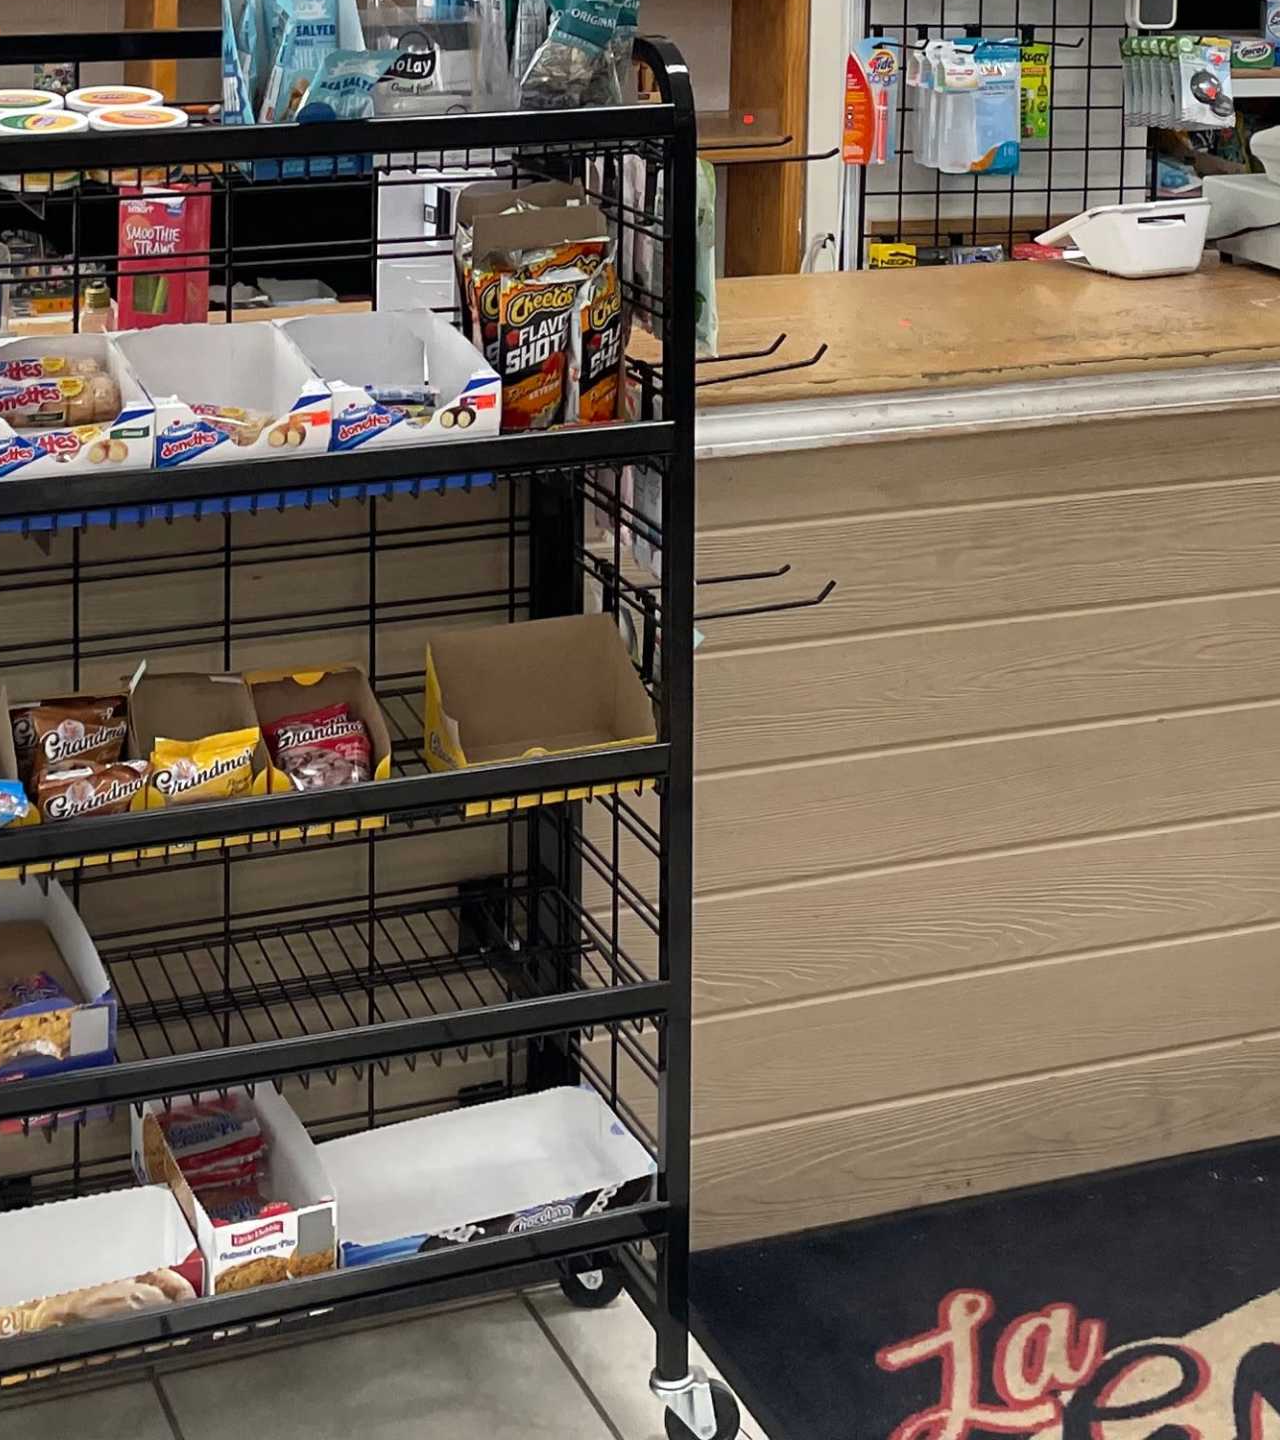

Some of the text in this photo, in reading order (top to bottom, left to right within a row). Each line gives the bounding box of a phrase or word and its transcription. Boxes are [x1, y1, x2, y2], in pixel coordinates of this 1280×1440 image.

[126, 224, 181, 242] SMOOTHIE
[134, 240, 176, 255] STRAWS
[509, 286, 575, 326] Cheetos
[338, 413, 391, 441] donettes
[162, 431, 218, 458] donettes
[875, 1288, 1105, 1440] La
